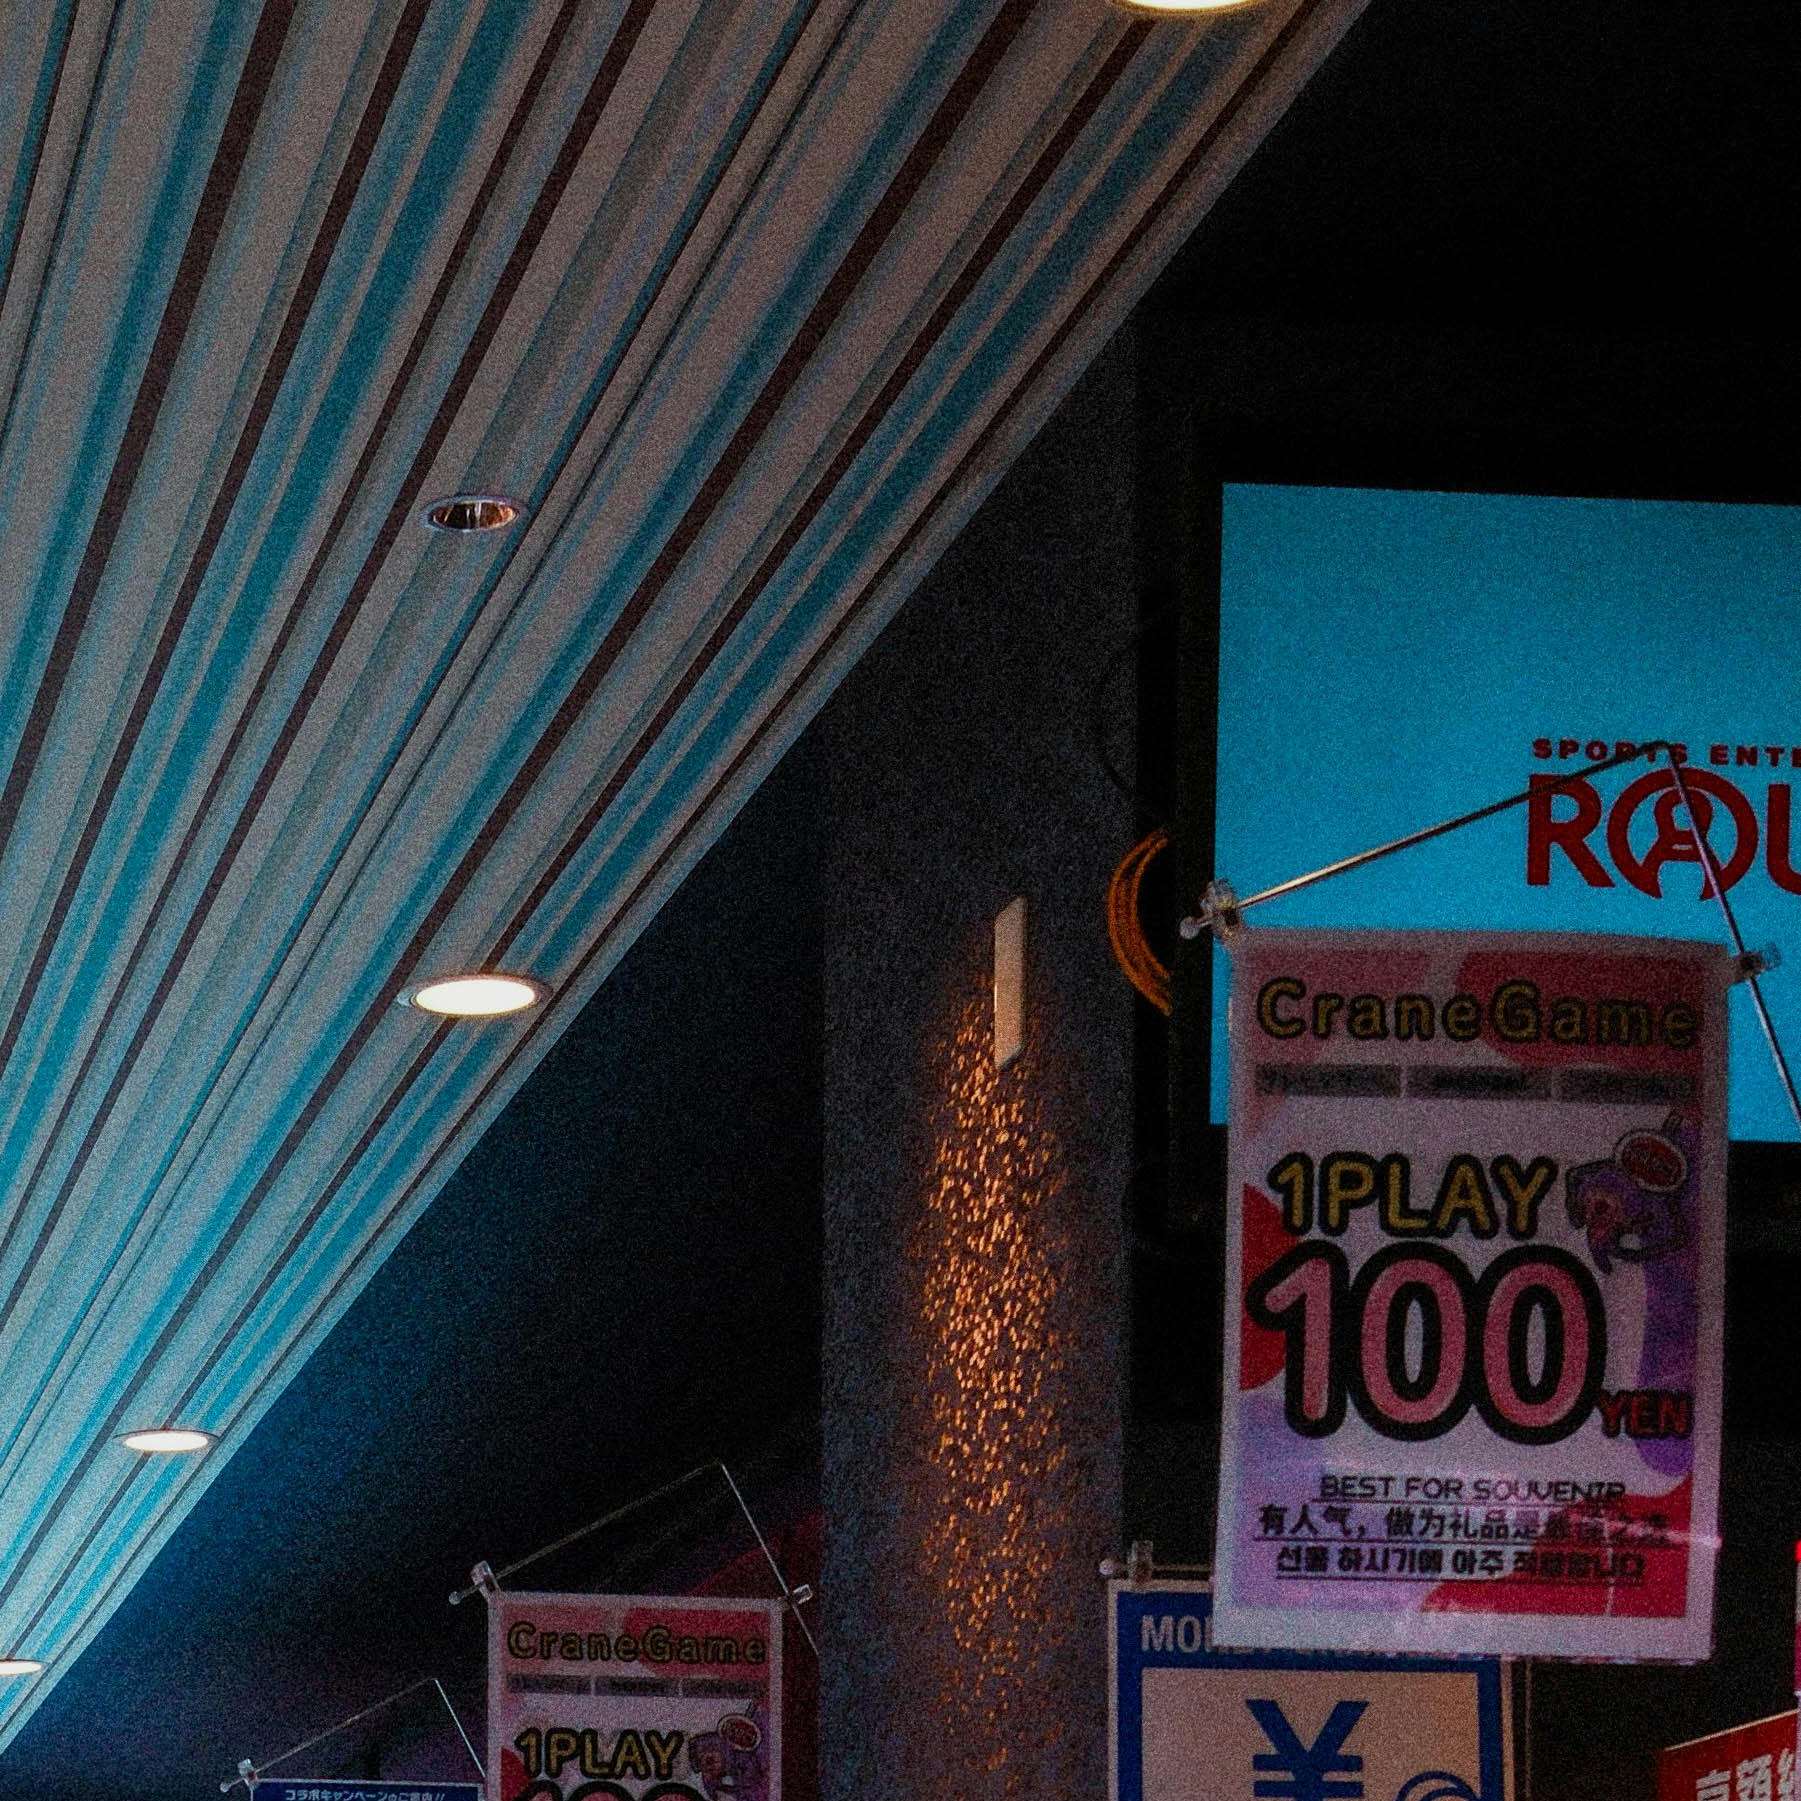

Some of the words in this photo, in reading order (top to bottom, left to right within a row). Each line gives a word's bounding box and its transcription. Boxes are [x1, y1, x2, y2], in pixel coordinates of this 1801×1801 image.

[1531, 738, 1688, 765] SPORTS
[1256, 976, 1700, 1049] CraneGame
[1268, 1151, 1558, 1240] 1PLAY
[1246, 1240, 1608, 1446] 100
[1598, 1389, 1694, 1440] YEN
[1320, 1474, 1376, 1500] BEST
[1407, 1476, 1465, 1501] FOR
[1474, 1477, 1626, 1503] SOUVENIR
[1452, 1550, 1504, 1576] 아주
[507, 1621, 767, 1665] CraneGame
[514, 1728, 687, 1781] 1PLAY
